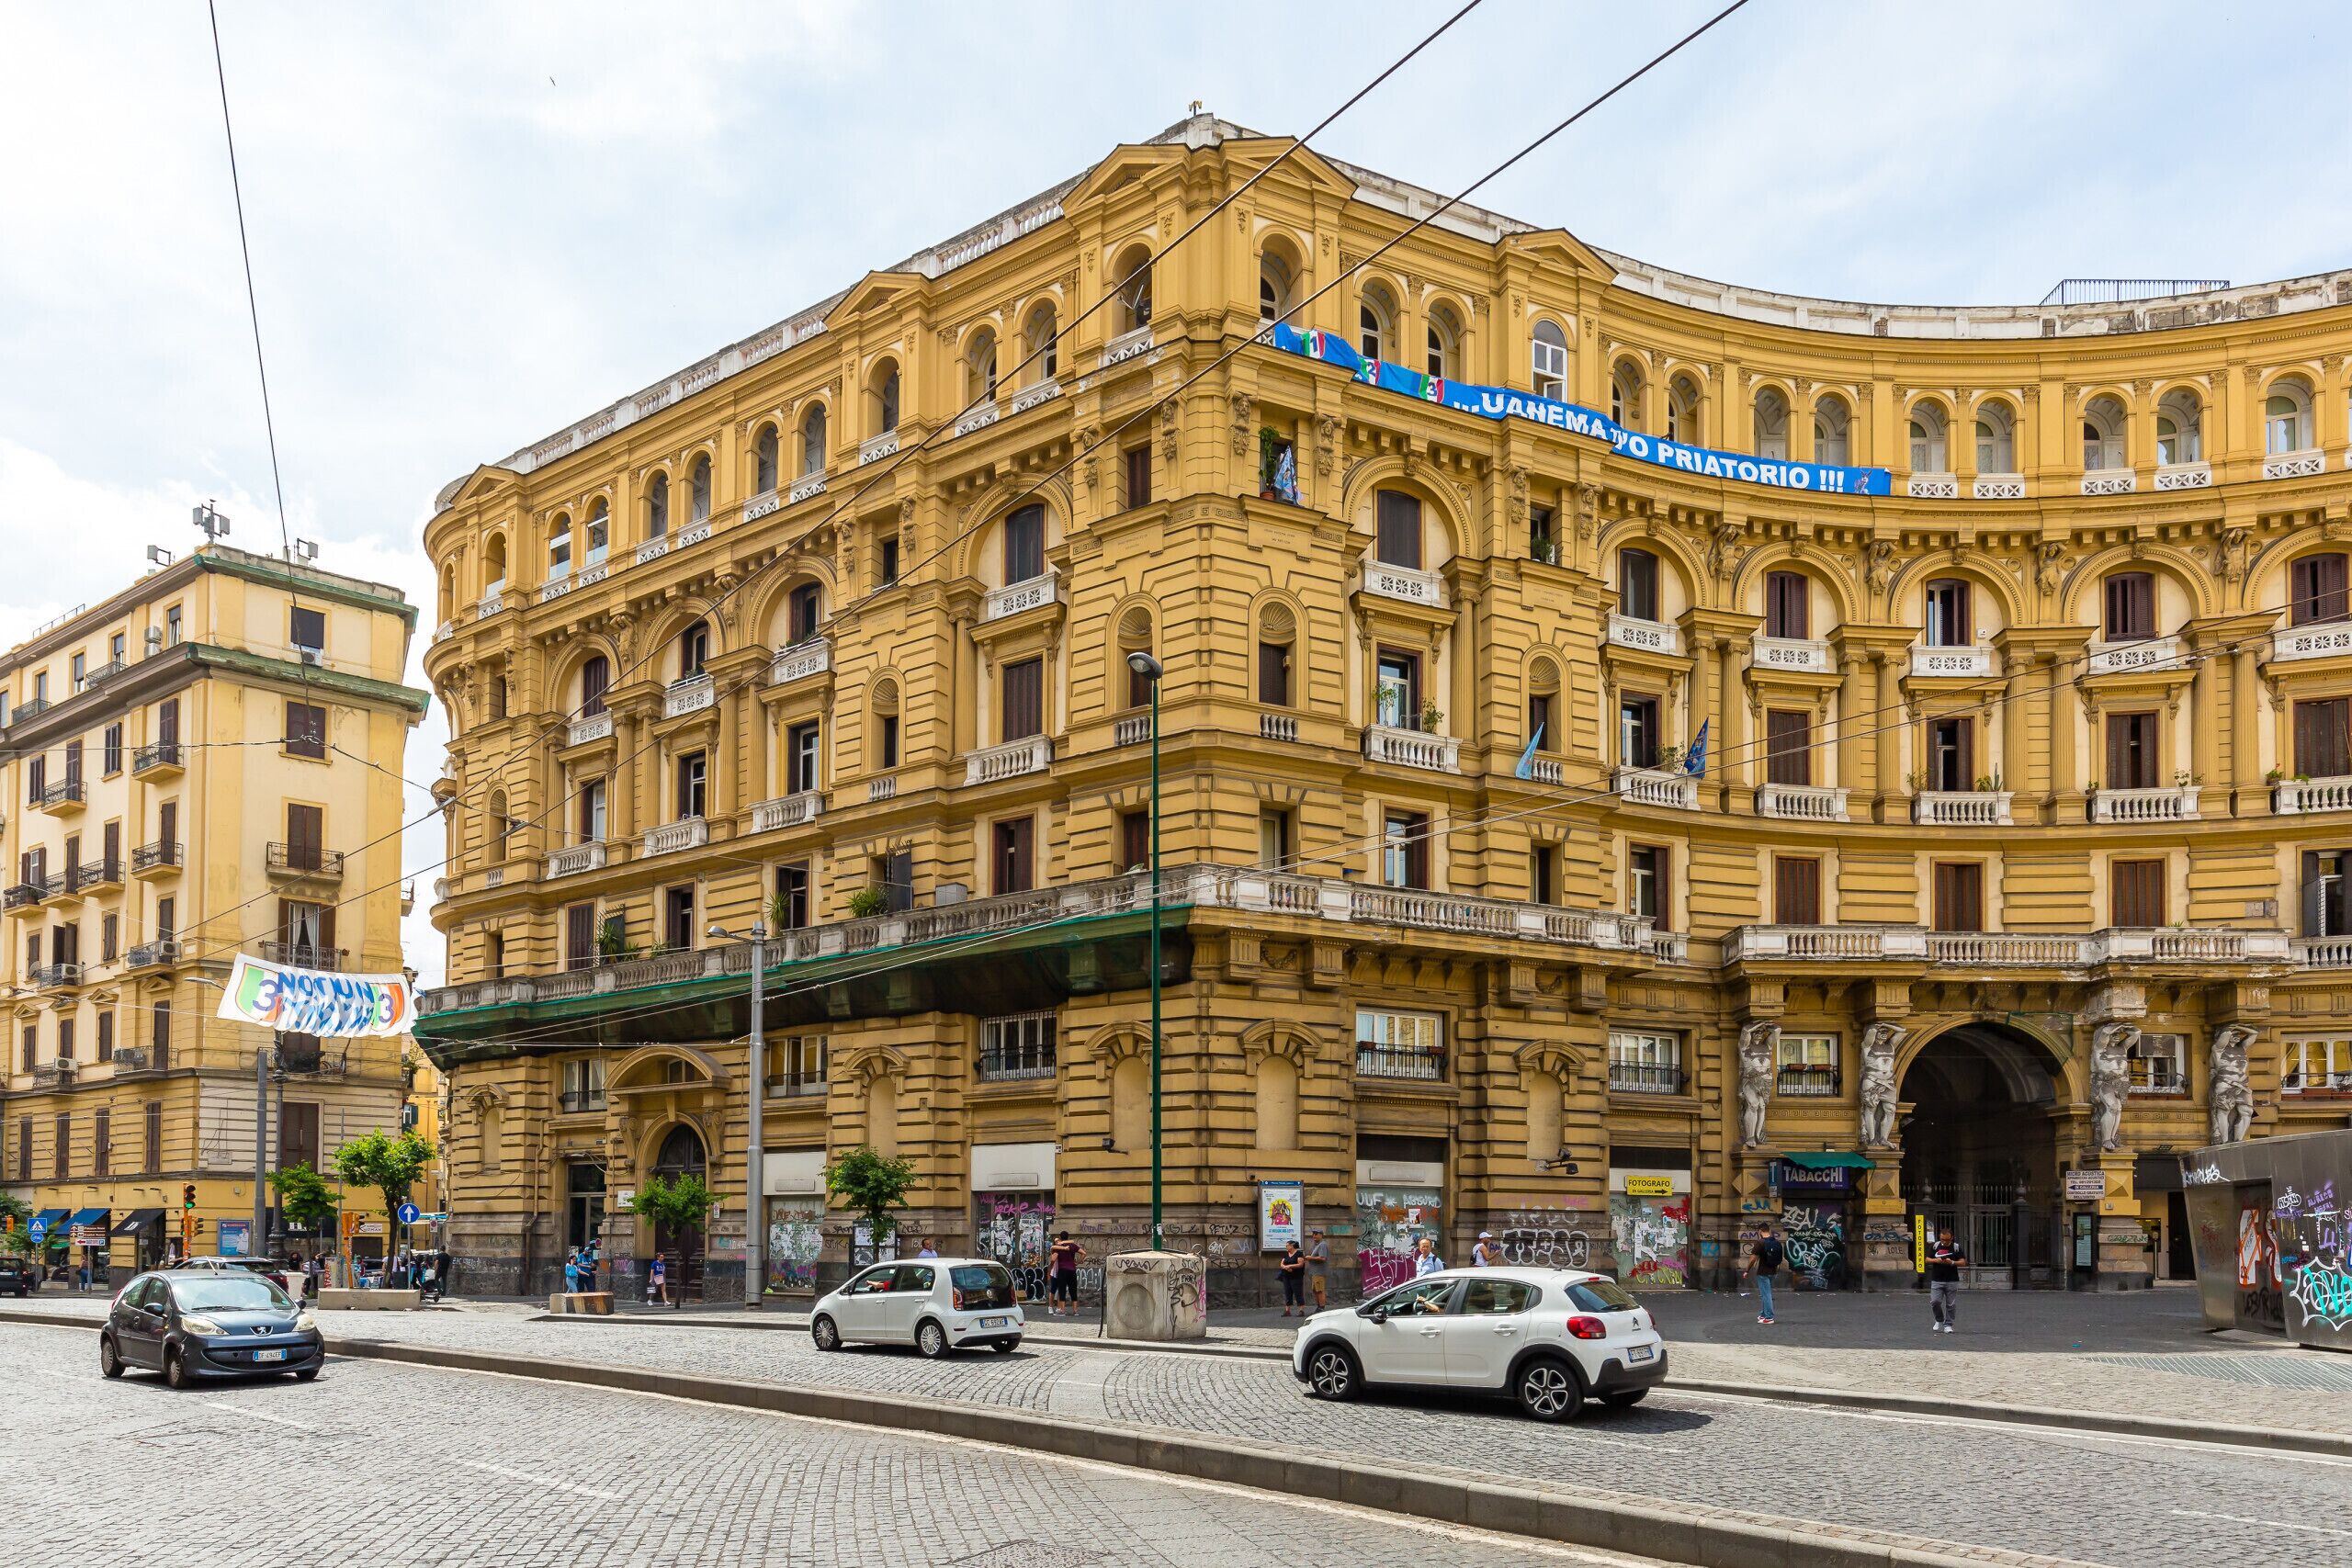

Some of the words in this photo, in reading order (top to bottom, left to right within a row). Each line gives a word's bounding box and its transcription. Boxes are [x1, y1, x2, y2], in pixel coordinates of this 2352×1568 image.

[1309, 335, 1318, 353] 1
[1427, 382, 1438, 396] 3
[1657, 443, 1810, 489] PRIATORIO
[1819, 469, 1844, 492] !!!
[253, 980, 279, 1011] 3
[379, 994, 394, 1023] 3
[1783, 1166, 1843, 1183] TABACCHI
[1628, 1179, 1670, 1188] FOTOGRAFO
